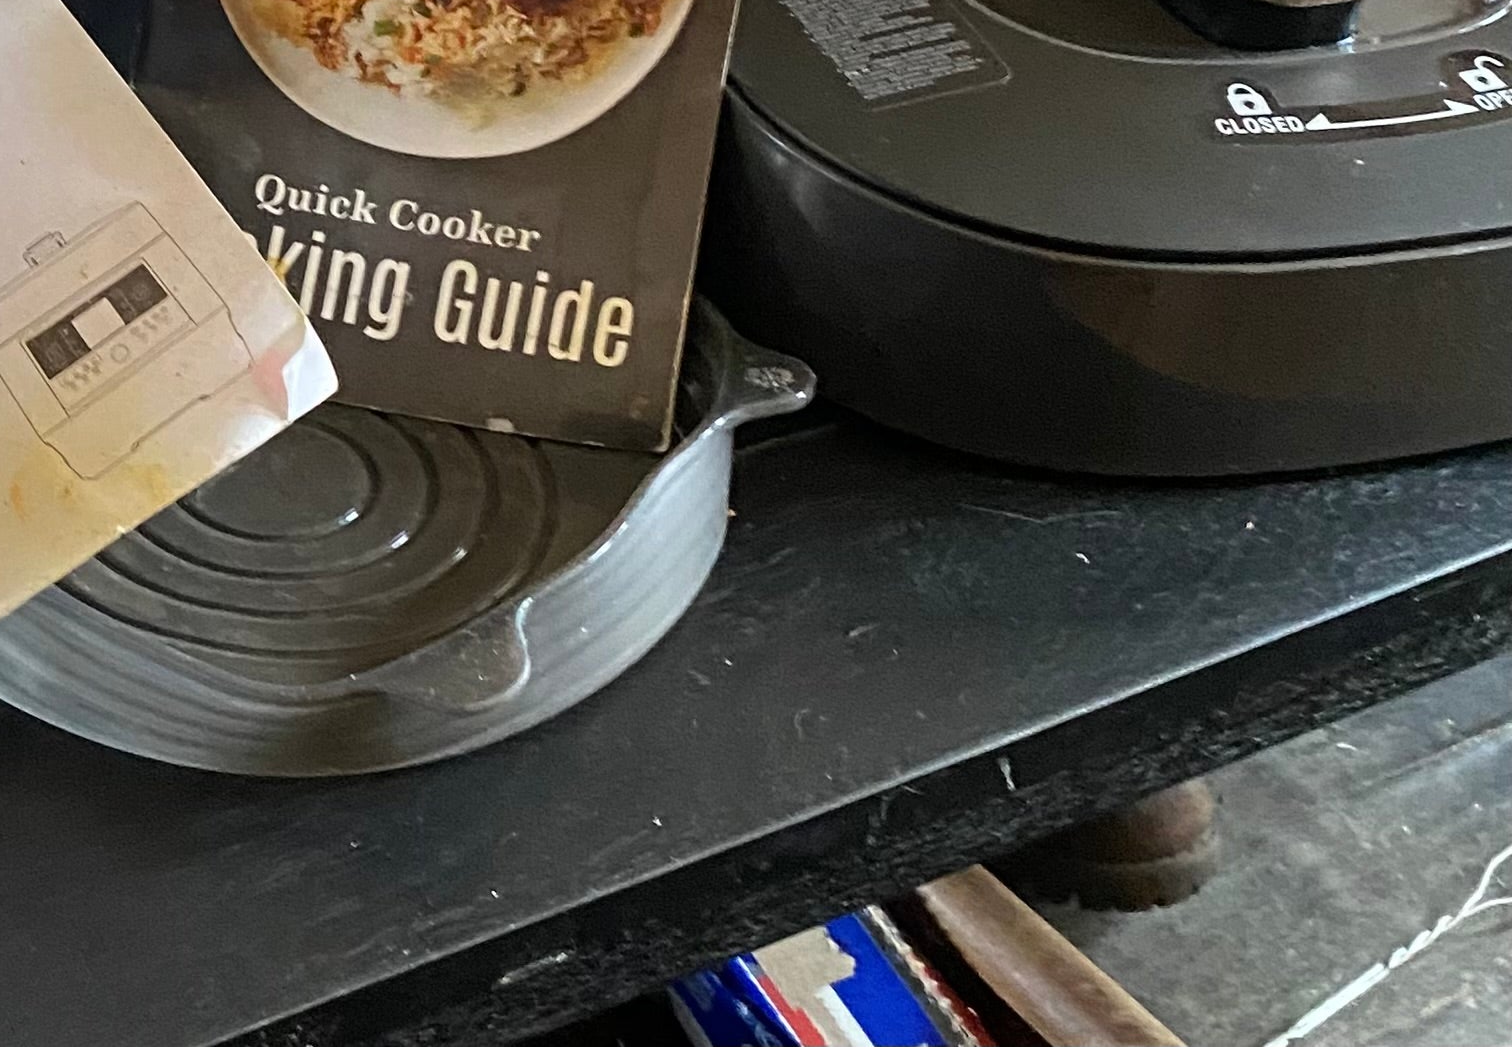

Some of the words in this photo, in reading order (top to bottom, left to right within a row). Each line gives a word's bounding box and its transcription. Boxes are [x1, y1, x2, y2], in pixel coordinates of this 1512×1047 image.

[1214, 115, 1306, 135] CLOSED
[255, 173, 377, 225] Quick
[388, 198, 544, 252] Cooker
[433, 258, 635, 368] Guide
